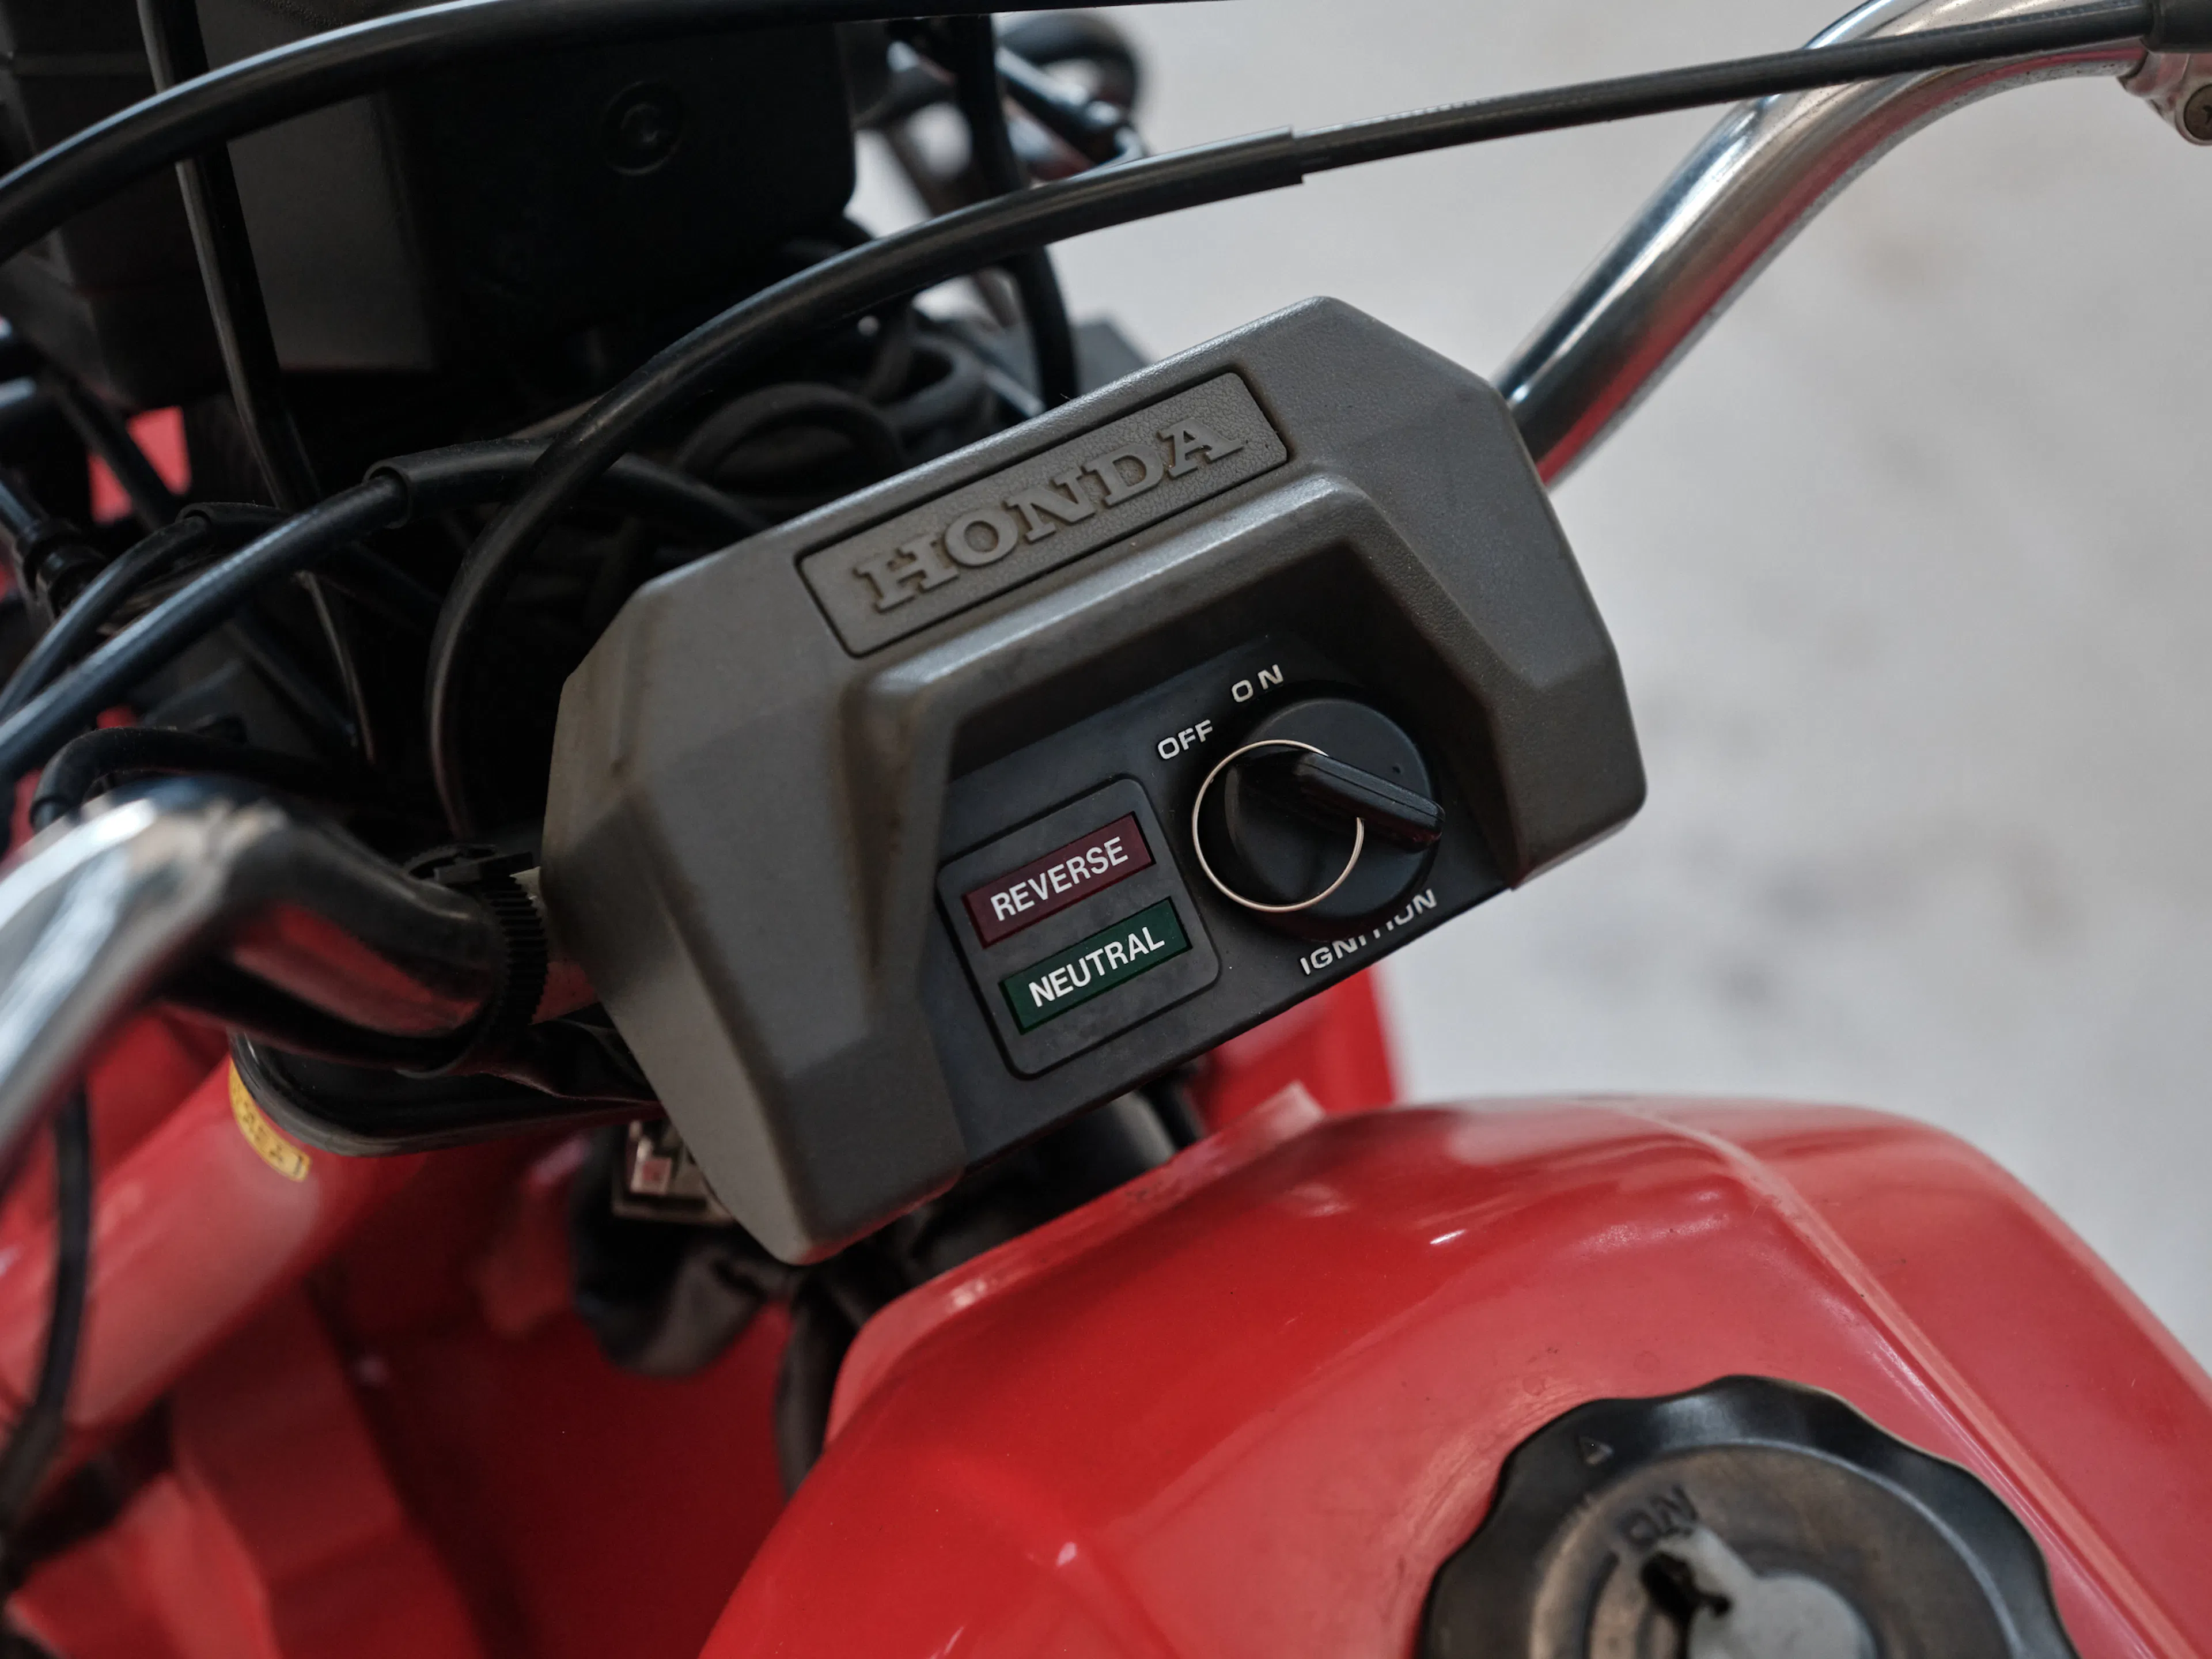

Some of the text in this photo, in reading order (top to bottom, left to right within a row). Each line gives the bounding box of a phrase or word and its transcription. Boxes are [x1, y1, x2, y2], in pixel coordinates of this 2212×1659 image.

[854, 418, 1244, 613] HONDA
[1232, 664, 1284, 702] ON
[1158, 719, 1213, 759] OFF
[990, 836, 1128, 921] REVERSE
[1028, 926, 1165, 1007] NEUTRAL
